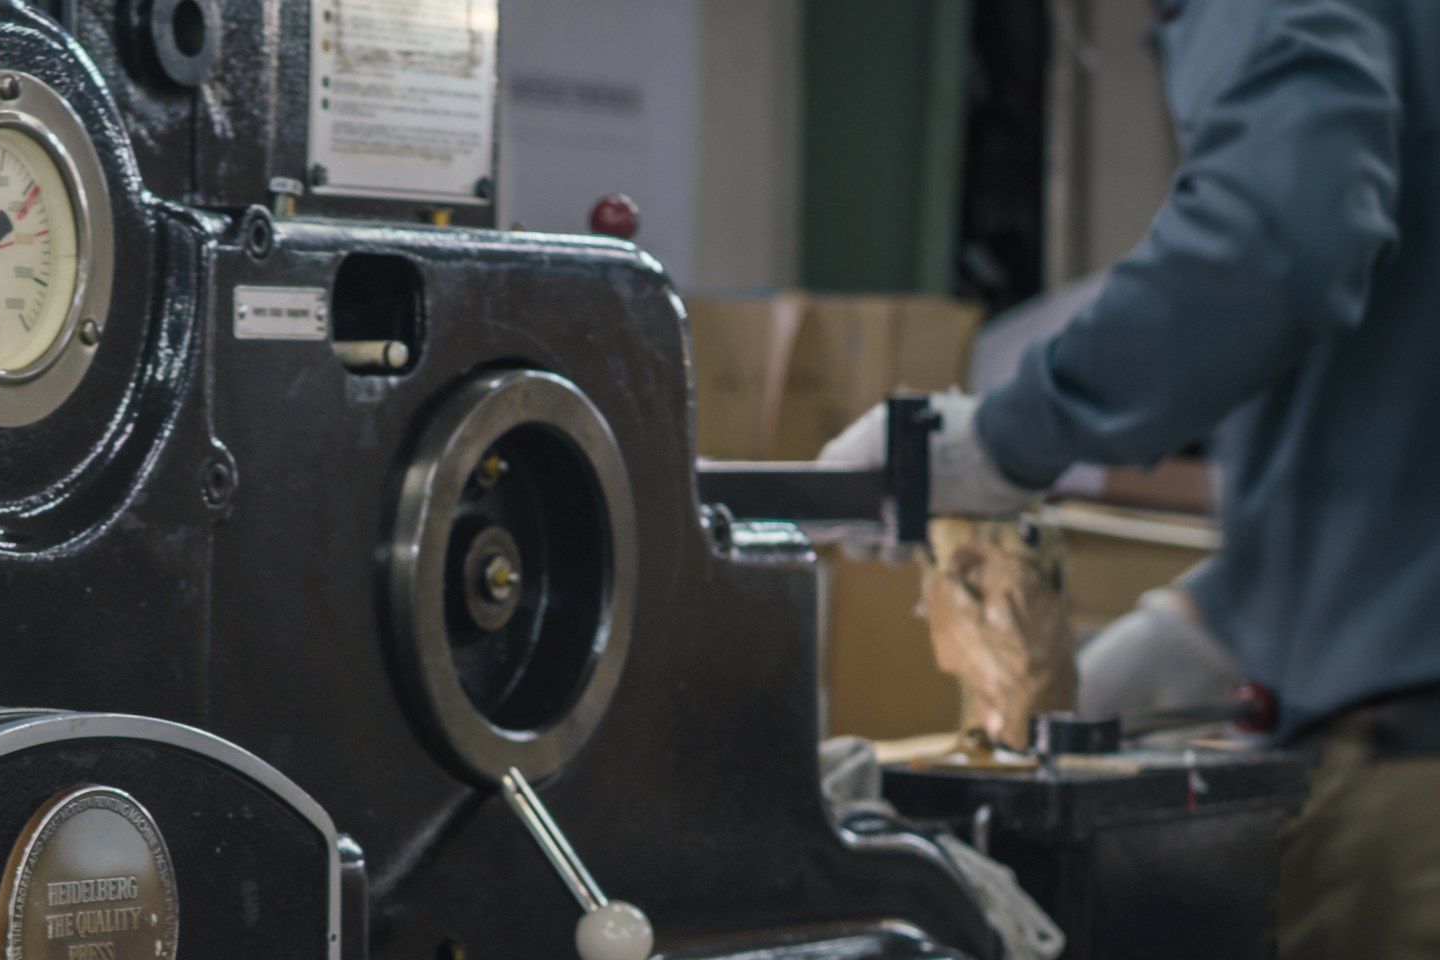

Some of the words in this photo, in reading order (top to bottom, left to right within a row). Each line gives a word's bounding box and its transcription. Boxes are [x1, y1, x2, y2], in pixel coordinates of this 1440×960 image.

[14, 867, 32, 919] LARGEST
[47, 876, 139, 906] HEIDELBERG
[45, 912, 75, 940] THE
[75, 907, 143, 938] QUALITY
